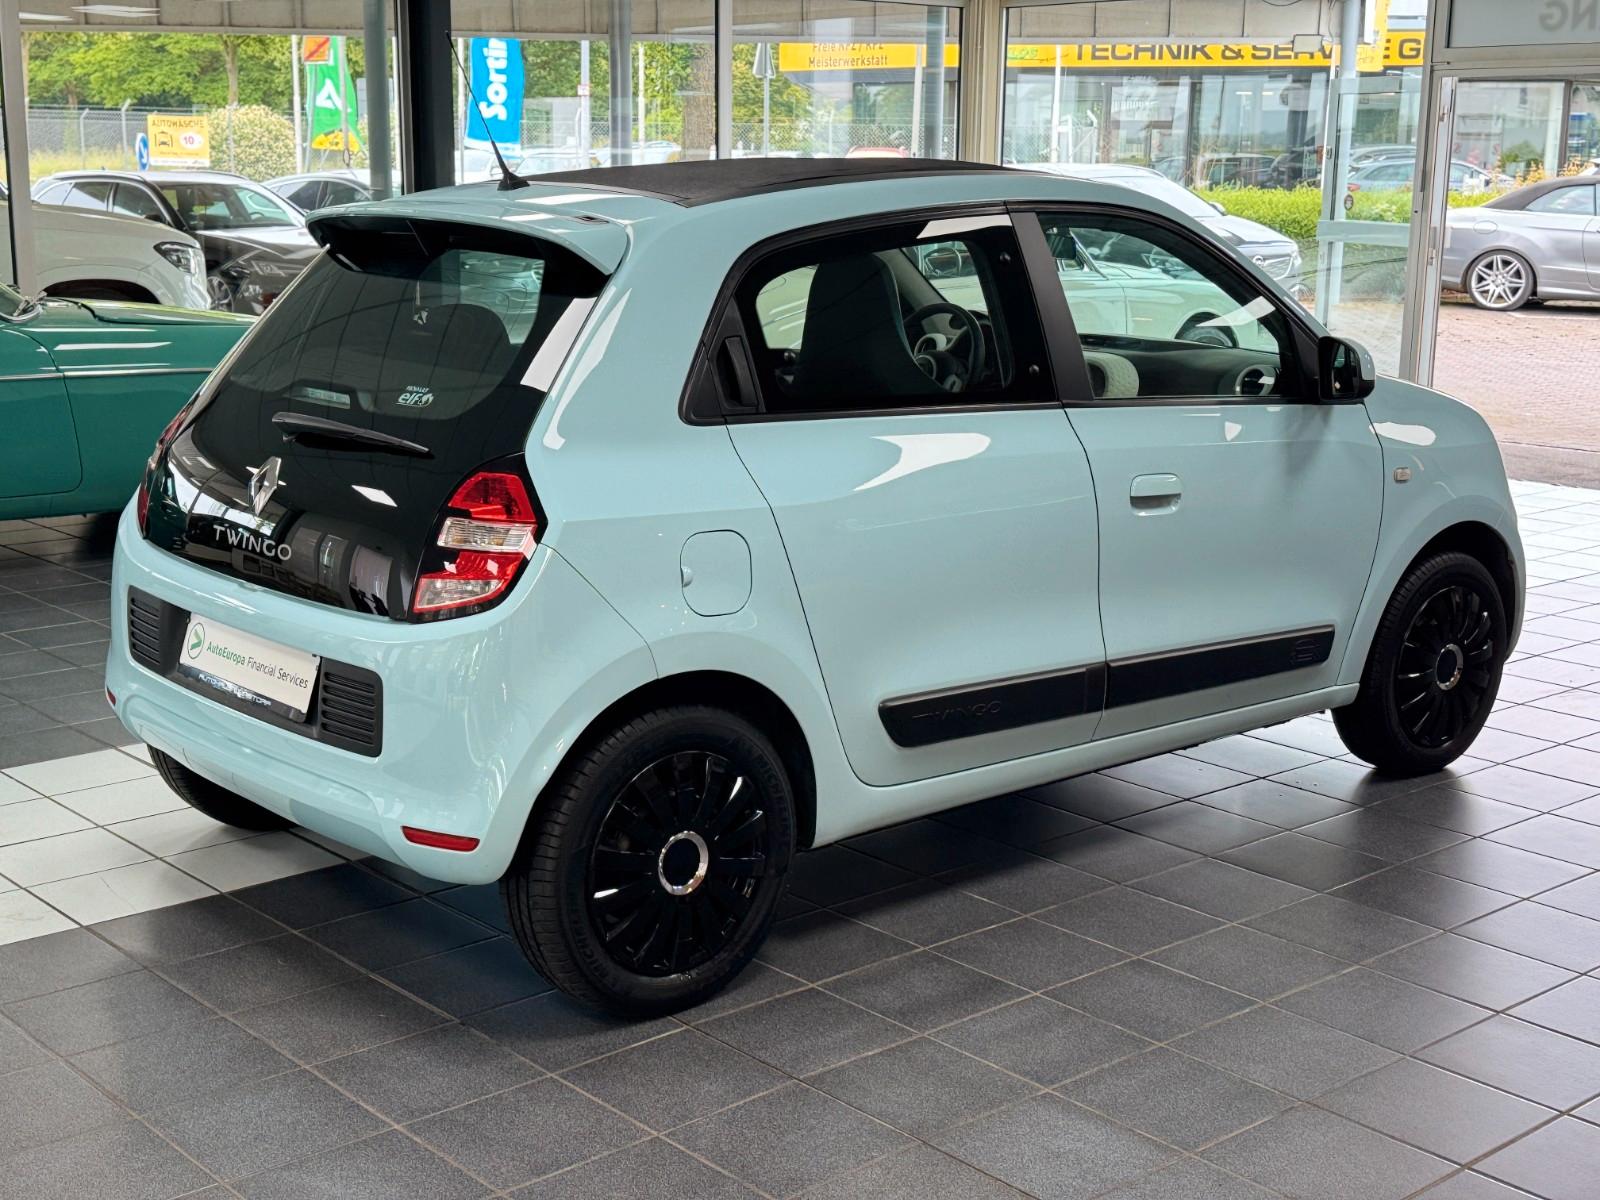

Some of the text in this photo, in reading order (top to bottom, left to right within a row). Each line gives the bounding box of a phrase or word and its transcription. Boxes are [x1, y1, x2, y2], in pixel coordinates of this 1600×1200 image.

[808, 55, 888, 68] Meisterwerkstatt
[1074, 44, 1214, 61] TECHNIK
[213, 524, 292, 561] TWINGO
[206, 641, 309, 689] AutoEuropa Financial Services
